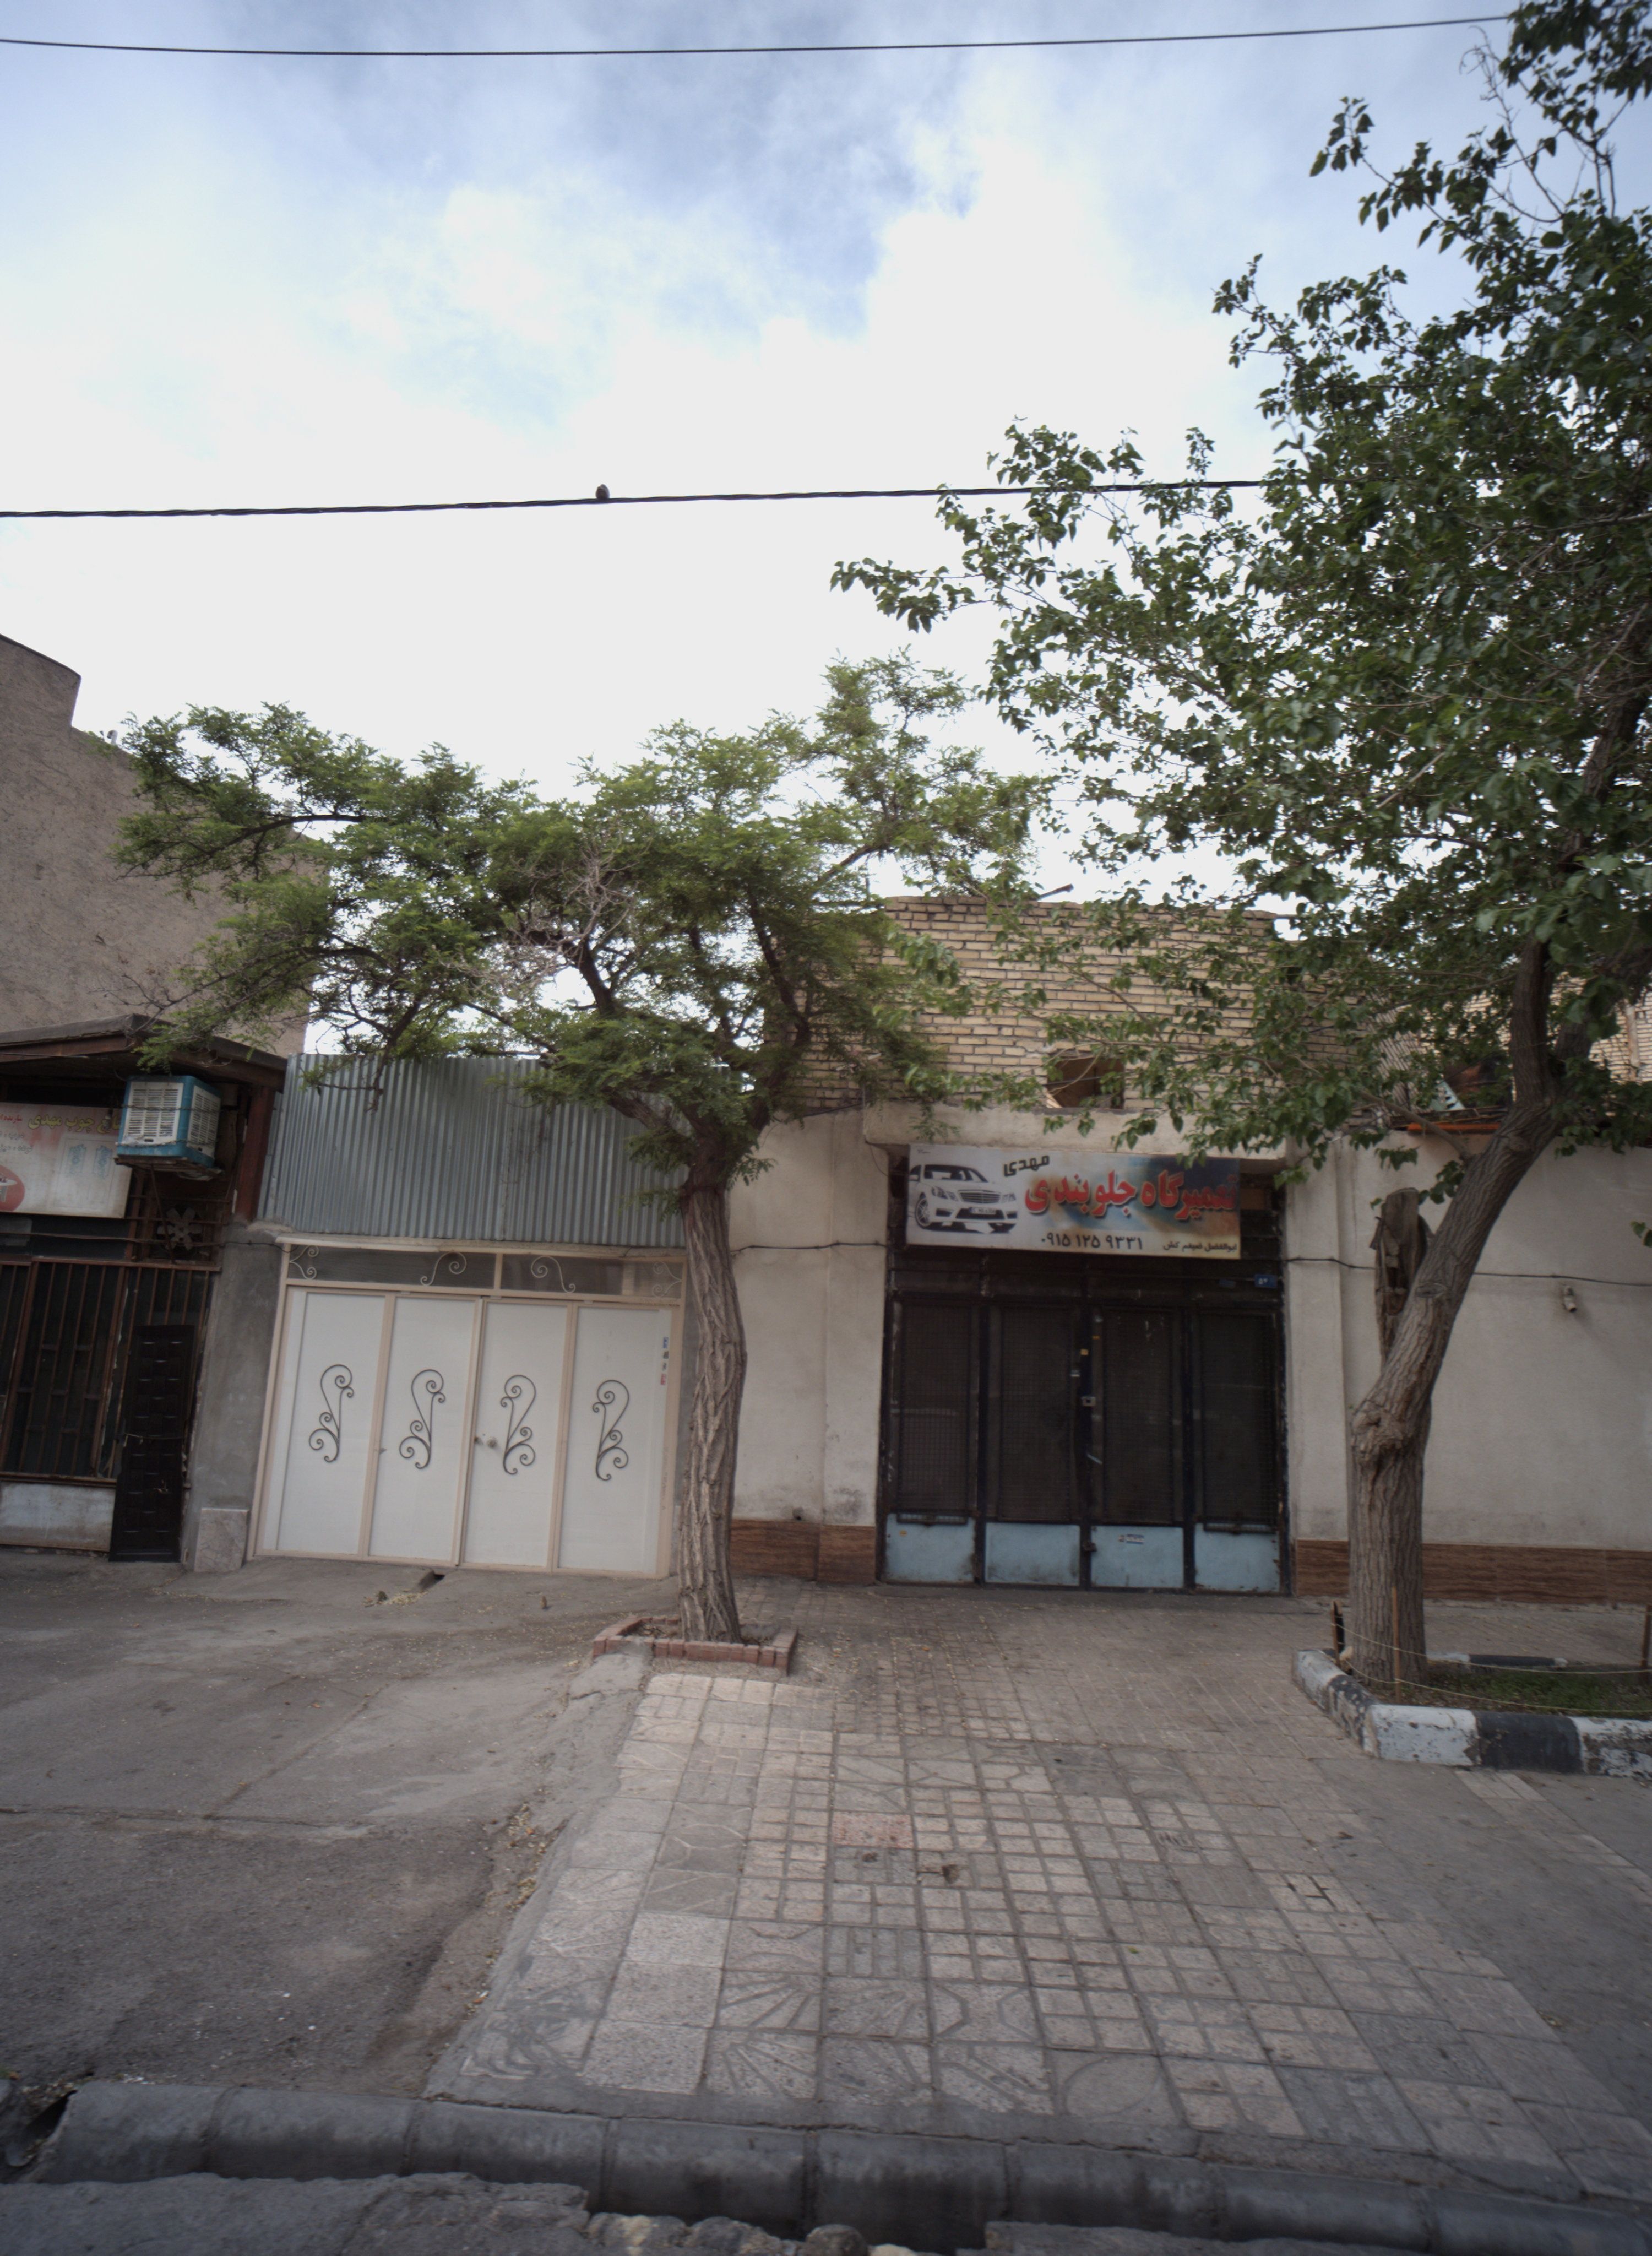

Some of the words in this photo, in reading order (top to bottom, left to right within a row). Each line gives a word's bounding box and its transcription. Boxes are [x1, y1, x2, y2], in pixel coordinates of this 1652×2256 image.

[28, 1114, 63, 1130] مهدی
[65, 1117, 95, 1134] چوب
[1003, 1155, 1050, 1178] مهدی
[1141, 1169, 1239, 1222] تعمیرگاه
[1041, 1232, 1072, 1247] ۰۹۱۵
[1076, 1234, 1101, 1249] ۱۲۵
[1106, 1235, 1143, 1250] ۹۳۳۱
[1204, 1242, 1237, 1252] ابوالفضل
